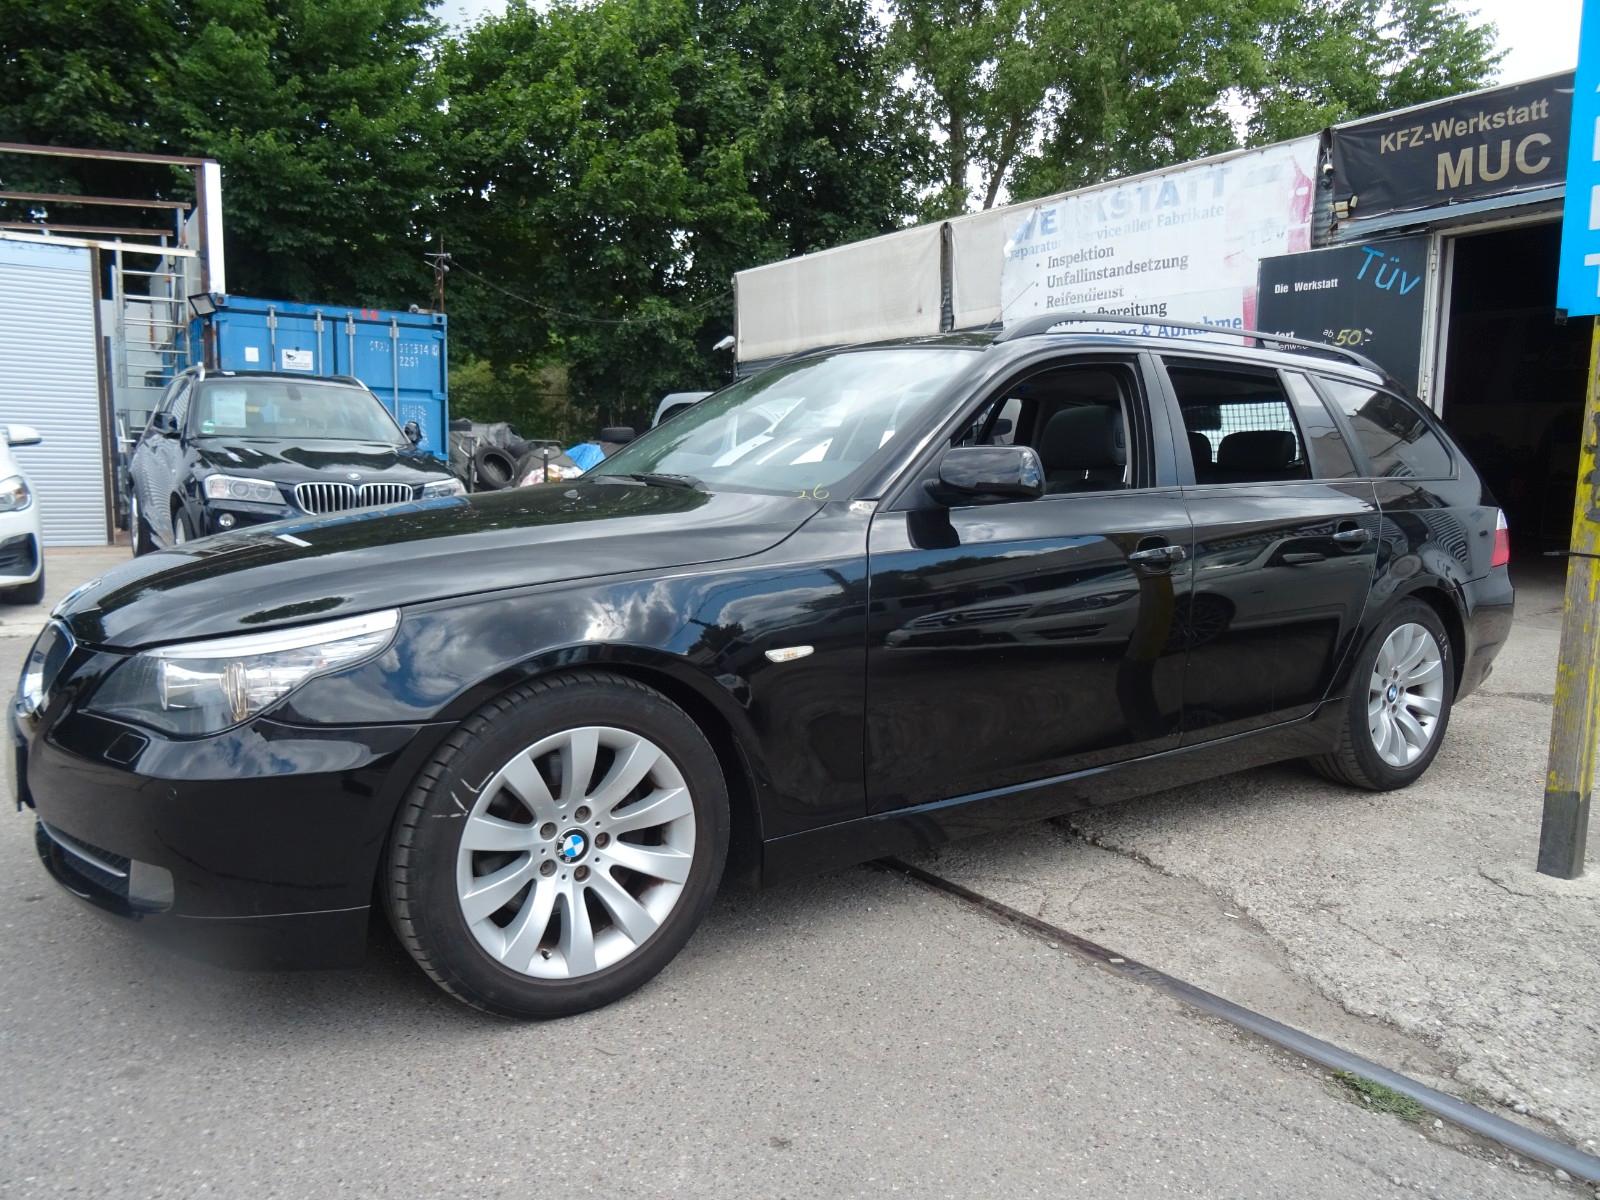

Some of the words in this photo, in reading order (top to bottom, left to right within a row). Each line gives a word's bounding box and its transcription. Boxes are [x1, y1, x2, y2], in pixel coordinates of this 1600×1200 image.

[1380, 98, 1550, 154] KFZ-Werkstatt
[1436, 133, 1552, 191] MUC
[1047, 245, 1115, 269] Inspektion
[1046, 255, 1189, 288] Unfallinstandsetzung
[1046, 286, 1125, 309] Reifendienst
[1274, 284, 1289, 294] Die
[1294, 278, 1339, 292] Werkstatt
